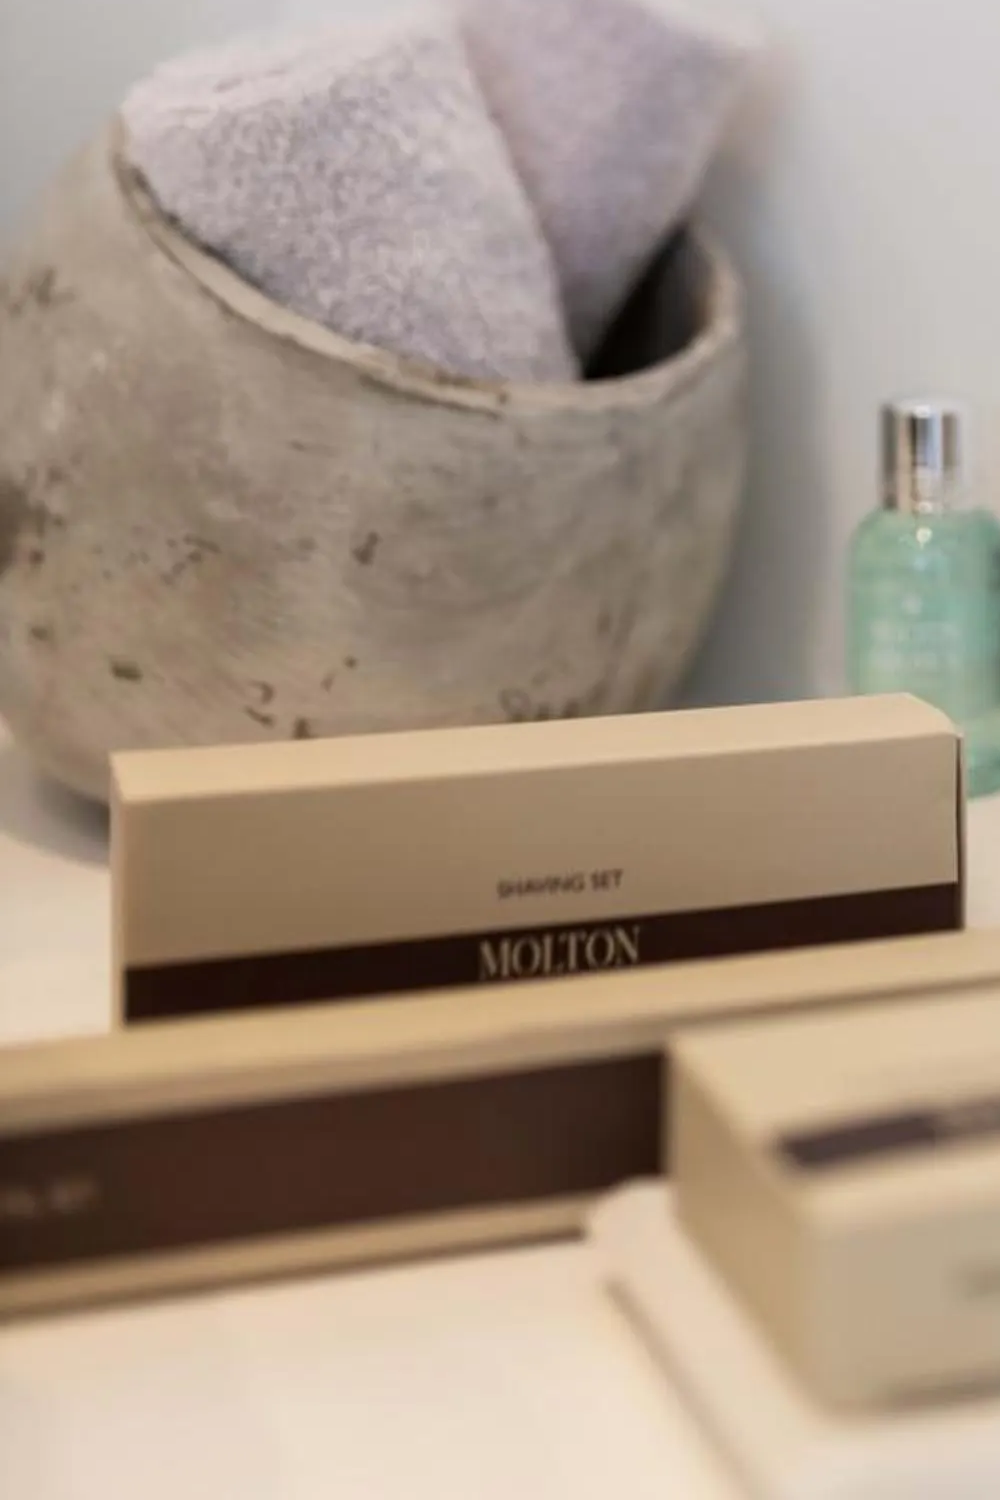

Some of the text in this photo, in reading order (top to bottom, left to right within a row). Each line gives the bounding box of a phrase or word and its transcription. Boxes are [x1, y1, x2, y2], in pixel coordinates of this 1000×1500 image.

[497, 868, 624, 898] SHAVING SET
[479, 925, 641, 982] MOLTON
